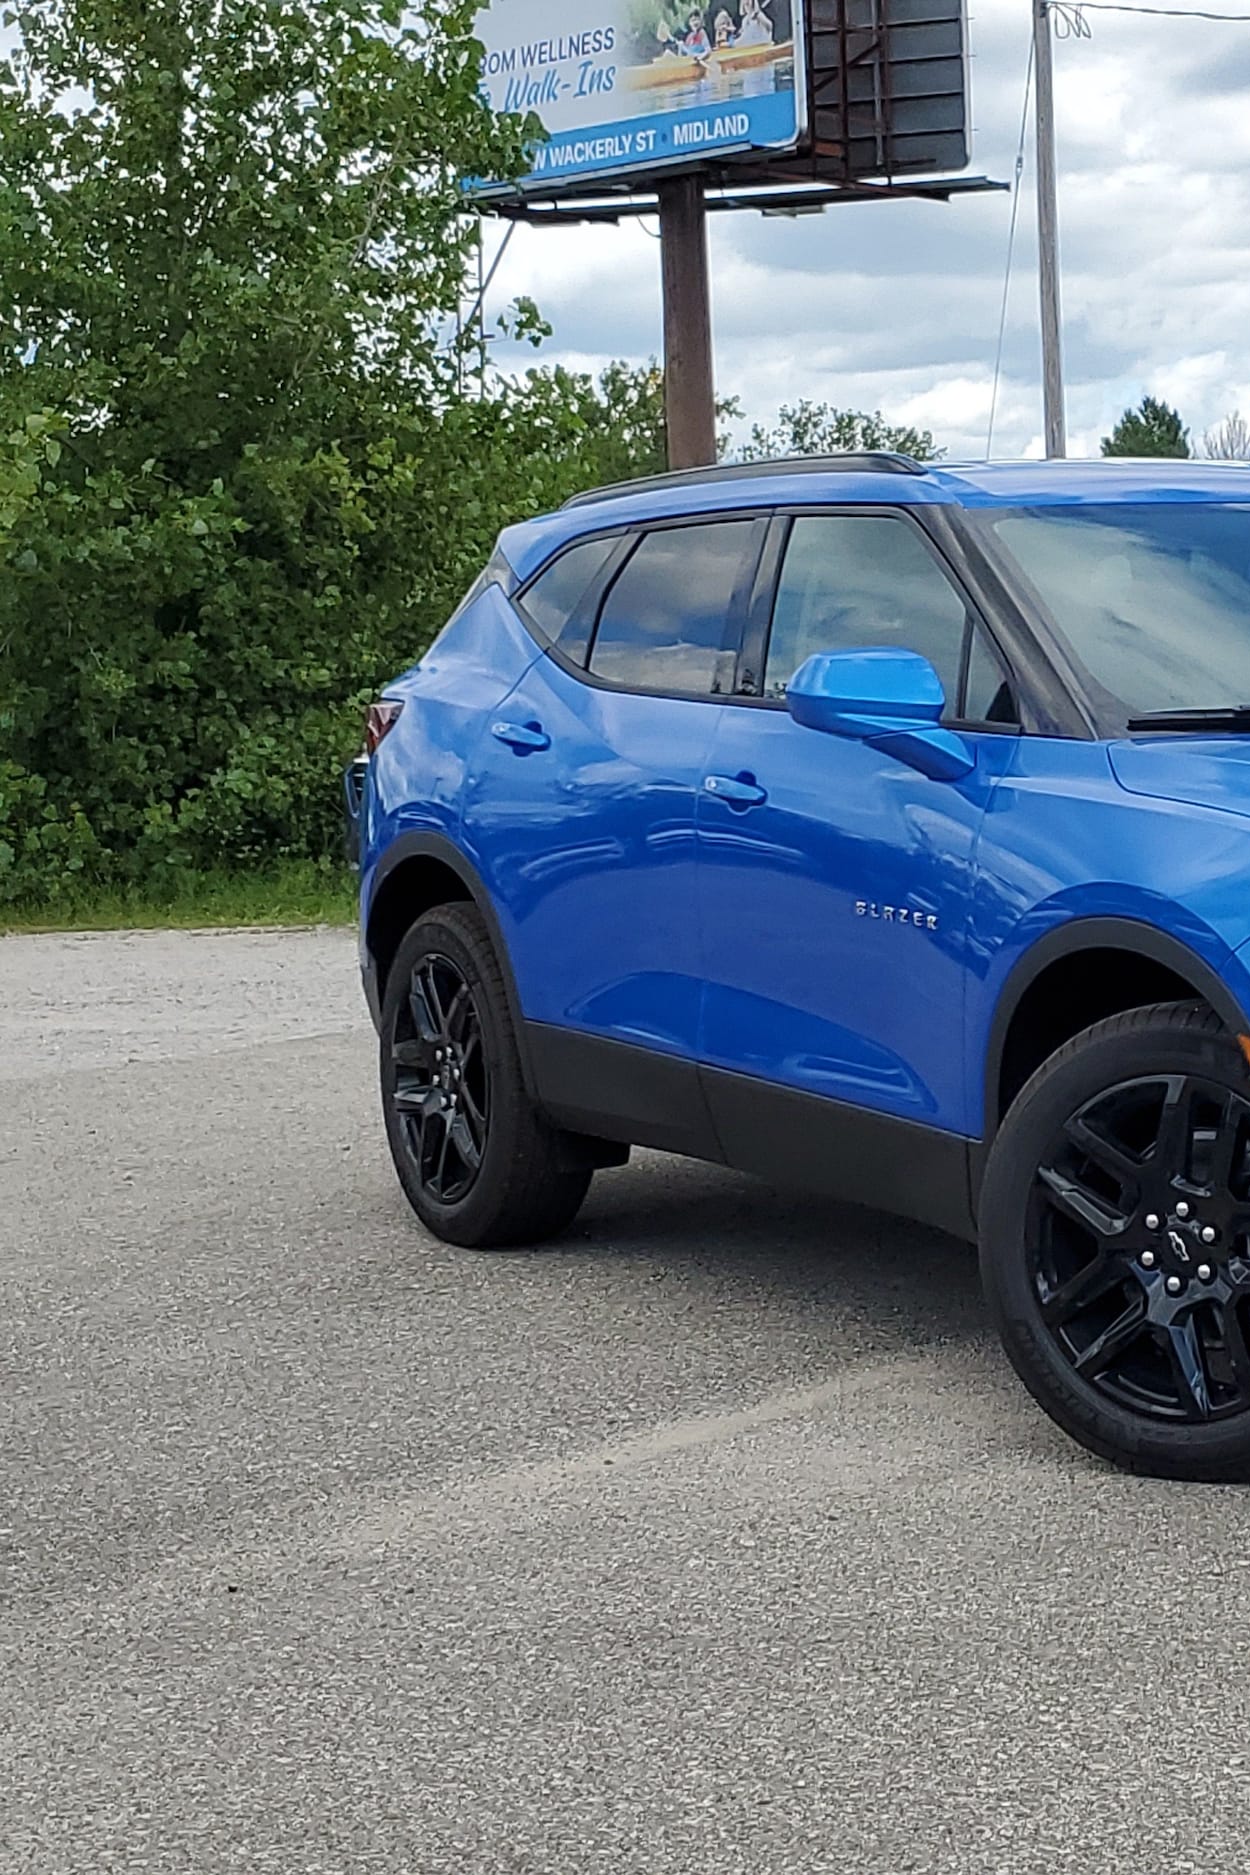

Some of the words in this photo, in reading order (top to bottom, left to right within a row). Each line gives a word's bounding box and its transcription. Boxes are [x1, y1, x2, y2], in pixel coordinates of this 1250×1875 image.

[521, 27, 614, 67] WELLNESS
[504, 60, 616, 113] Walk-Ins
[549, 134, 632, 168] WACKERLY
[636, 130, 656, 152] ST
[673, 114, 749, 146] MIDLAND
[855, 901, 937, 930] BLAZER
